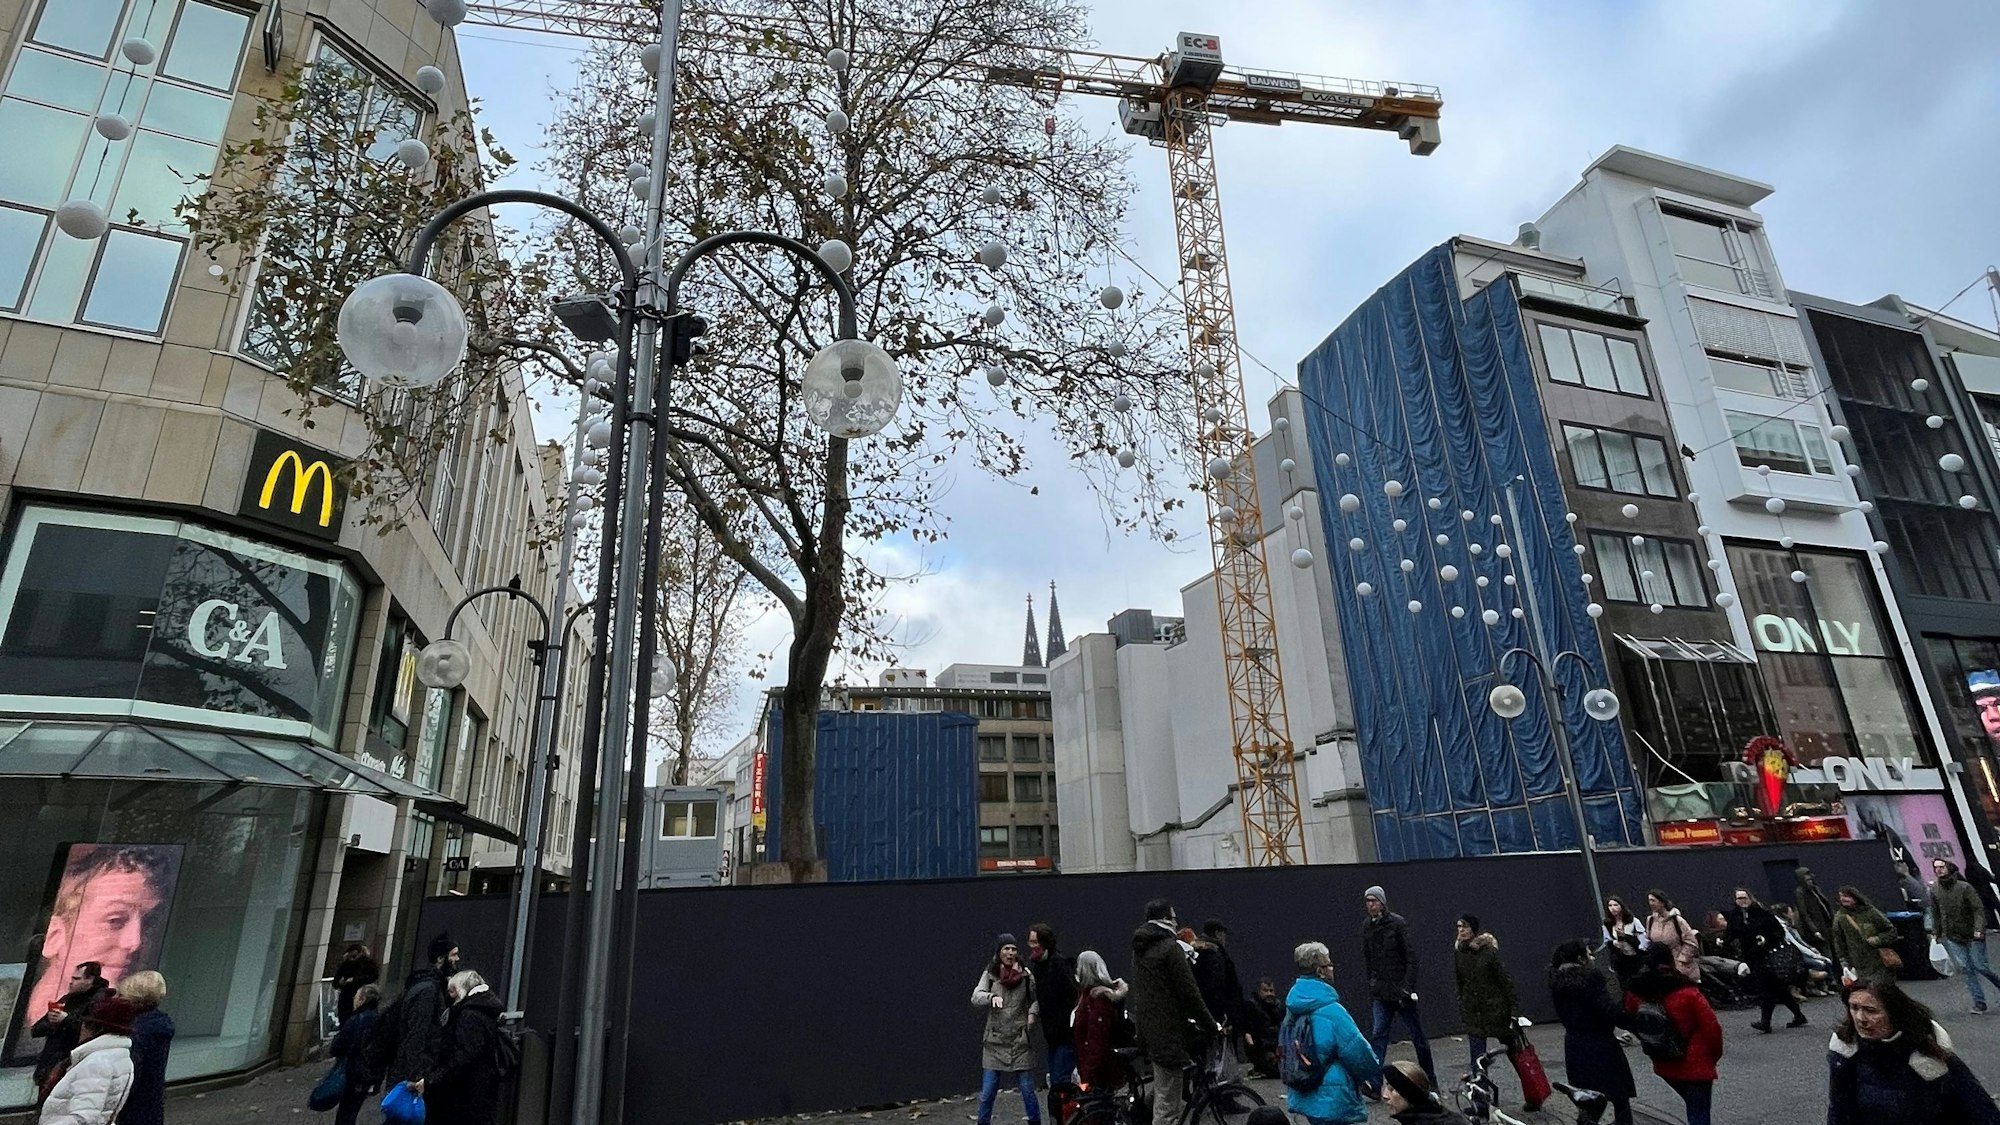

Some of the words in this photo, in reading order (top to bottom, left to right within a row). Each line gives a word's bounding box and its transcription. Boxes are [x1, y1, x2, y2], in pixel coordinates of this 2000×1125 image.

[1250, 76, 1299, 90] BAUWENS
[1312, 93, 1366, 107] WASEL
[188, 599, 287, 669] C&A
[1753, 614, 1862, 656] ONLY
[754, 753, 765, 813] PIZZERIA
[1823, 756, 1913, 792] ONLY
